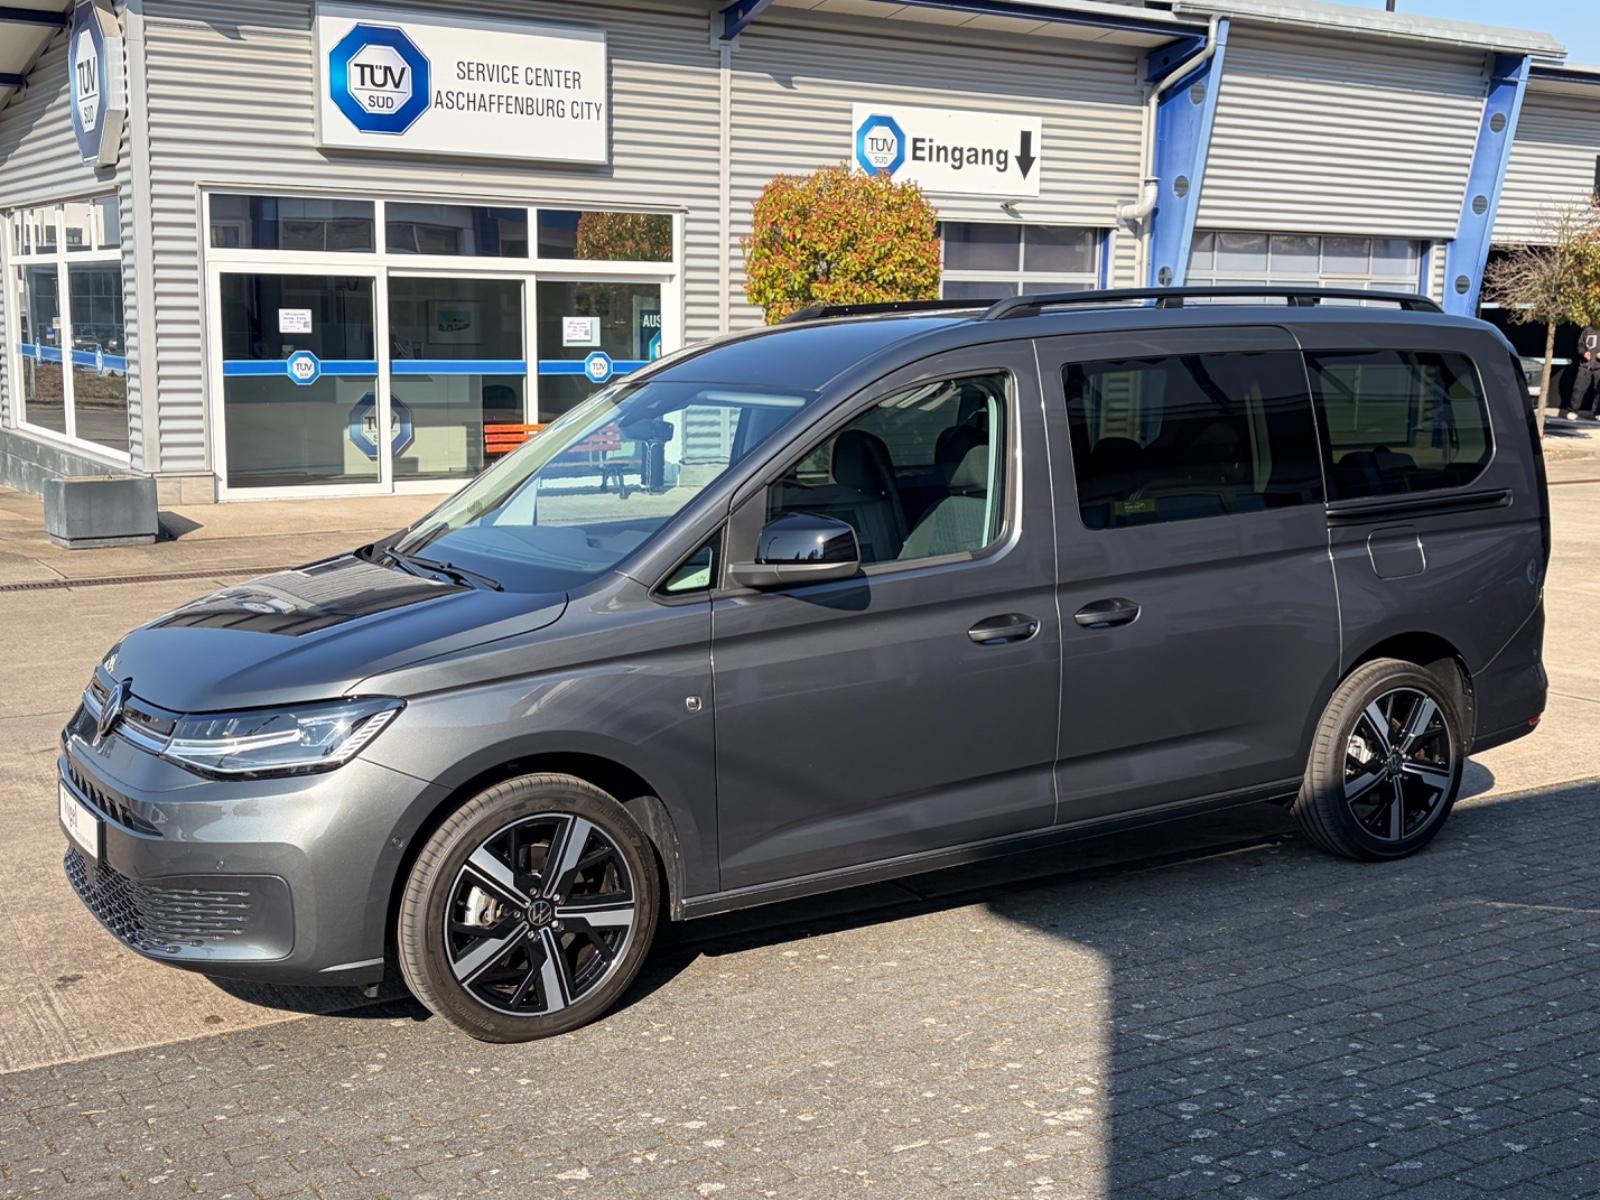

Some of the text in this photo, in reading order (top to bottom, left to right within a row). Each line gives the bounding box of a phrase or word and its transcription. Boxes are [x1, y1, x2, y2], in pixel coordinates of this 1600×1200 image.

[77, 56, 96, 96] TÜV
[354, 63, 407, 89] TÜV
[456, 61, 582, 90] SERVICE CENTER
[368, 94, 394, 109] SÜD
[434, 90, 603, 121] ASCHAFFENBURG CITY
[868, 137, 895, 152] TÜV
[911, 137, 1008, 173] Eingang
